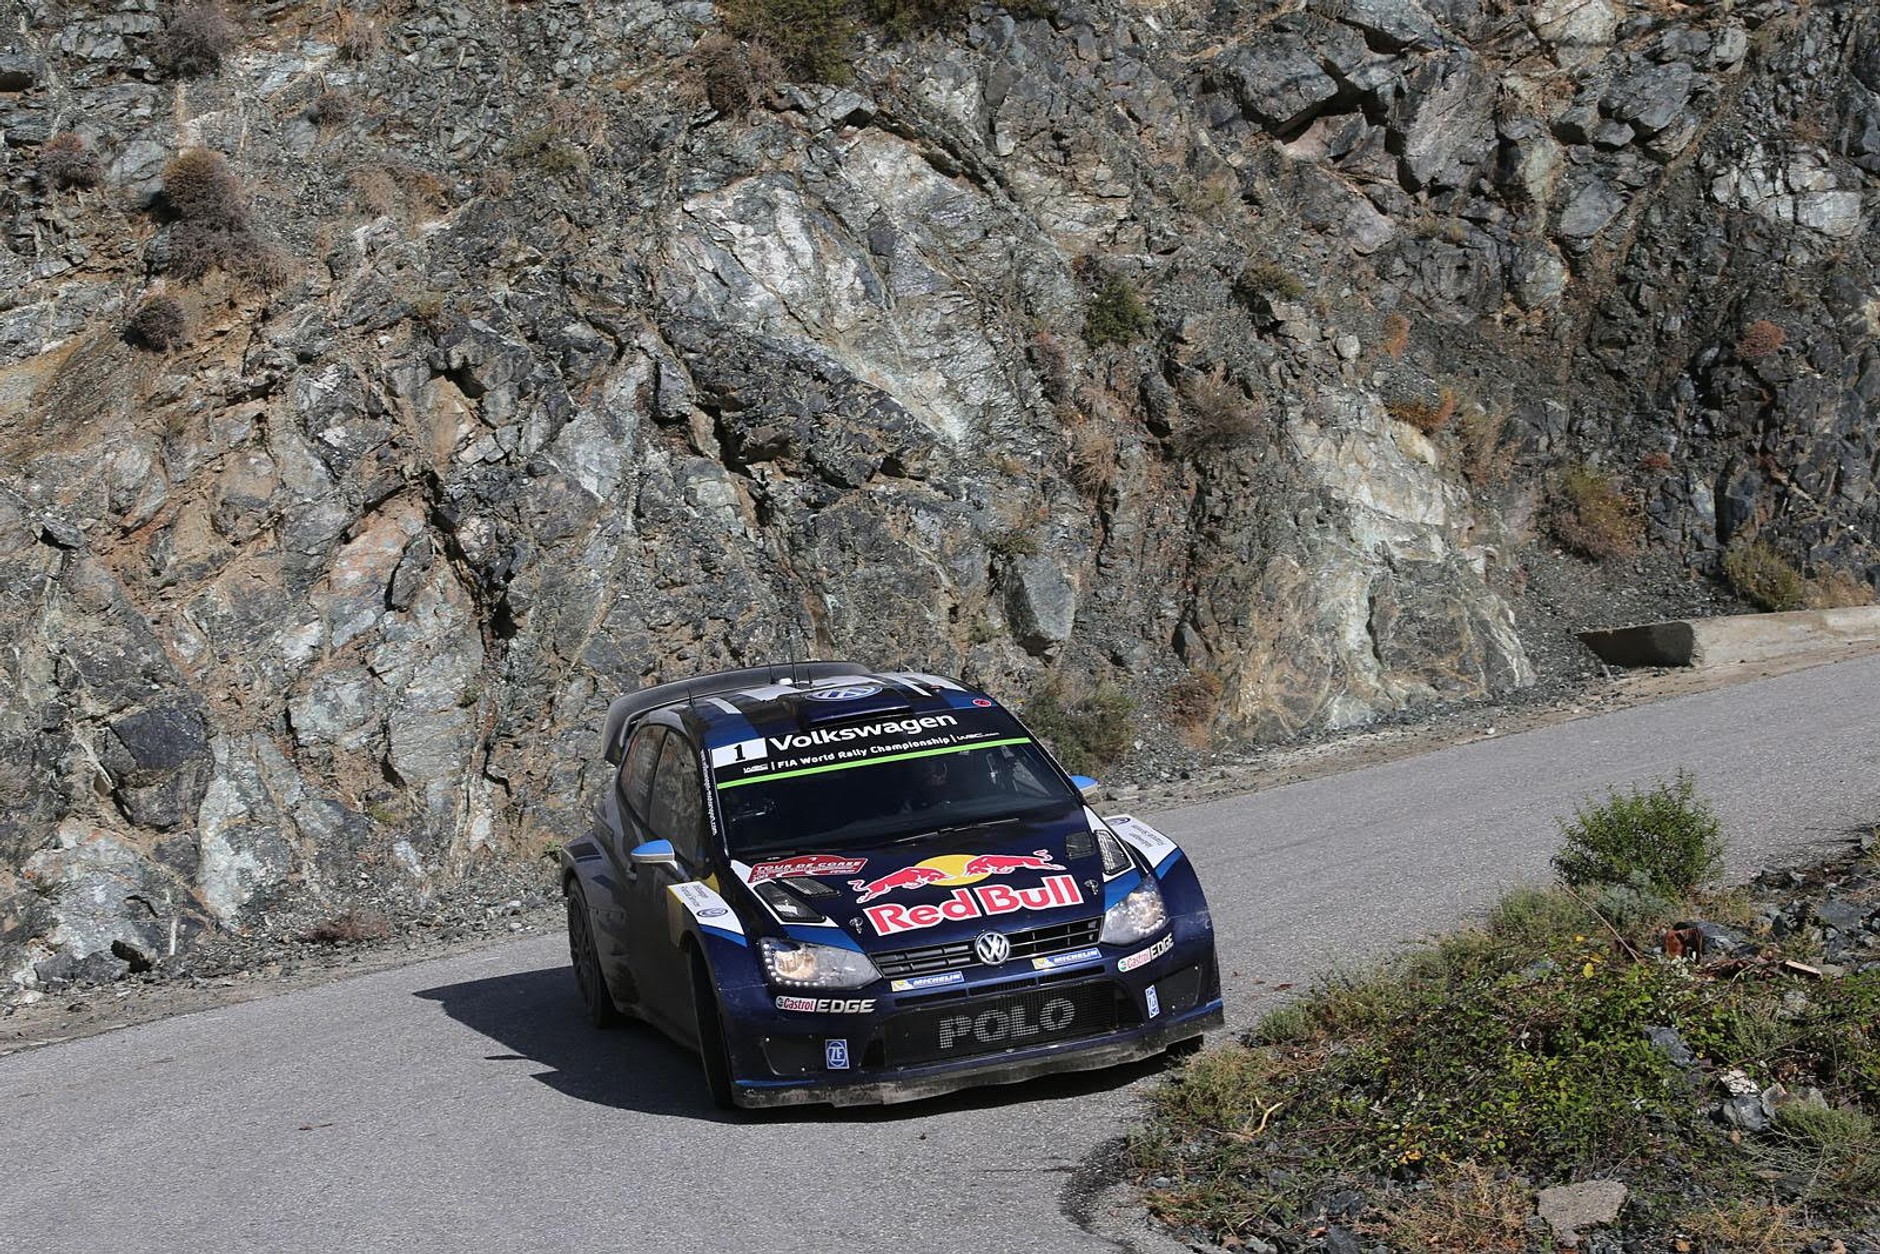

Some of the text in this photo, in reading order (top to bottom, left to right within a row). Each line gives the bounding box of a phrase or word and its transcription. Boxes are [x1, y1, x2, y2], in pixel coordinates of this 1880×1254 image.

[769, 714, 958, 751] Volkswagen
[734, 744, 746, 762] 1
[777, 759, 798, 769] FIA
[800, 752, 835, 765] World
[838, 748, 867, 759] Rally
[869, 737, 950, 754] Championship
[864, 875, 1084, 936] Red Bull
[1053, 950, 1099, 964] MICHELIN
[1150, 932, 1174, 960] EDGE
[913, 973, 961, 986] MICHELIN
[783, 997, 878, 1013] Castrol EDGE
[940, 998, 1076, 1049] POLO
[830, 1046, 845, 1062] ZF
